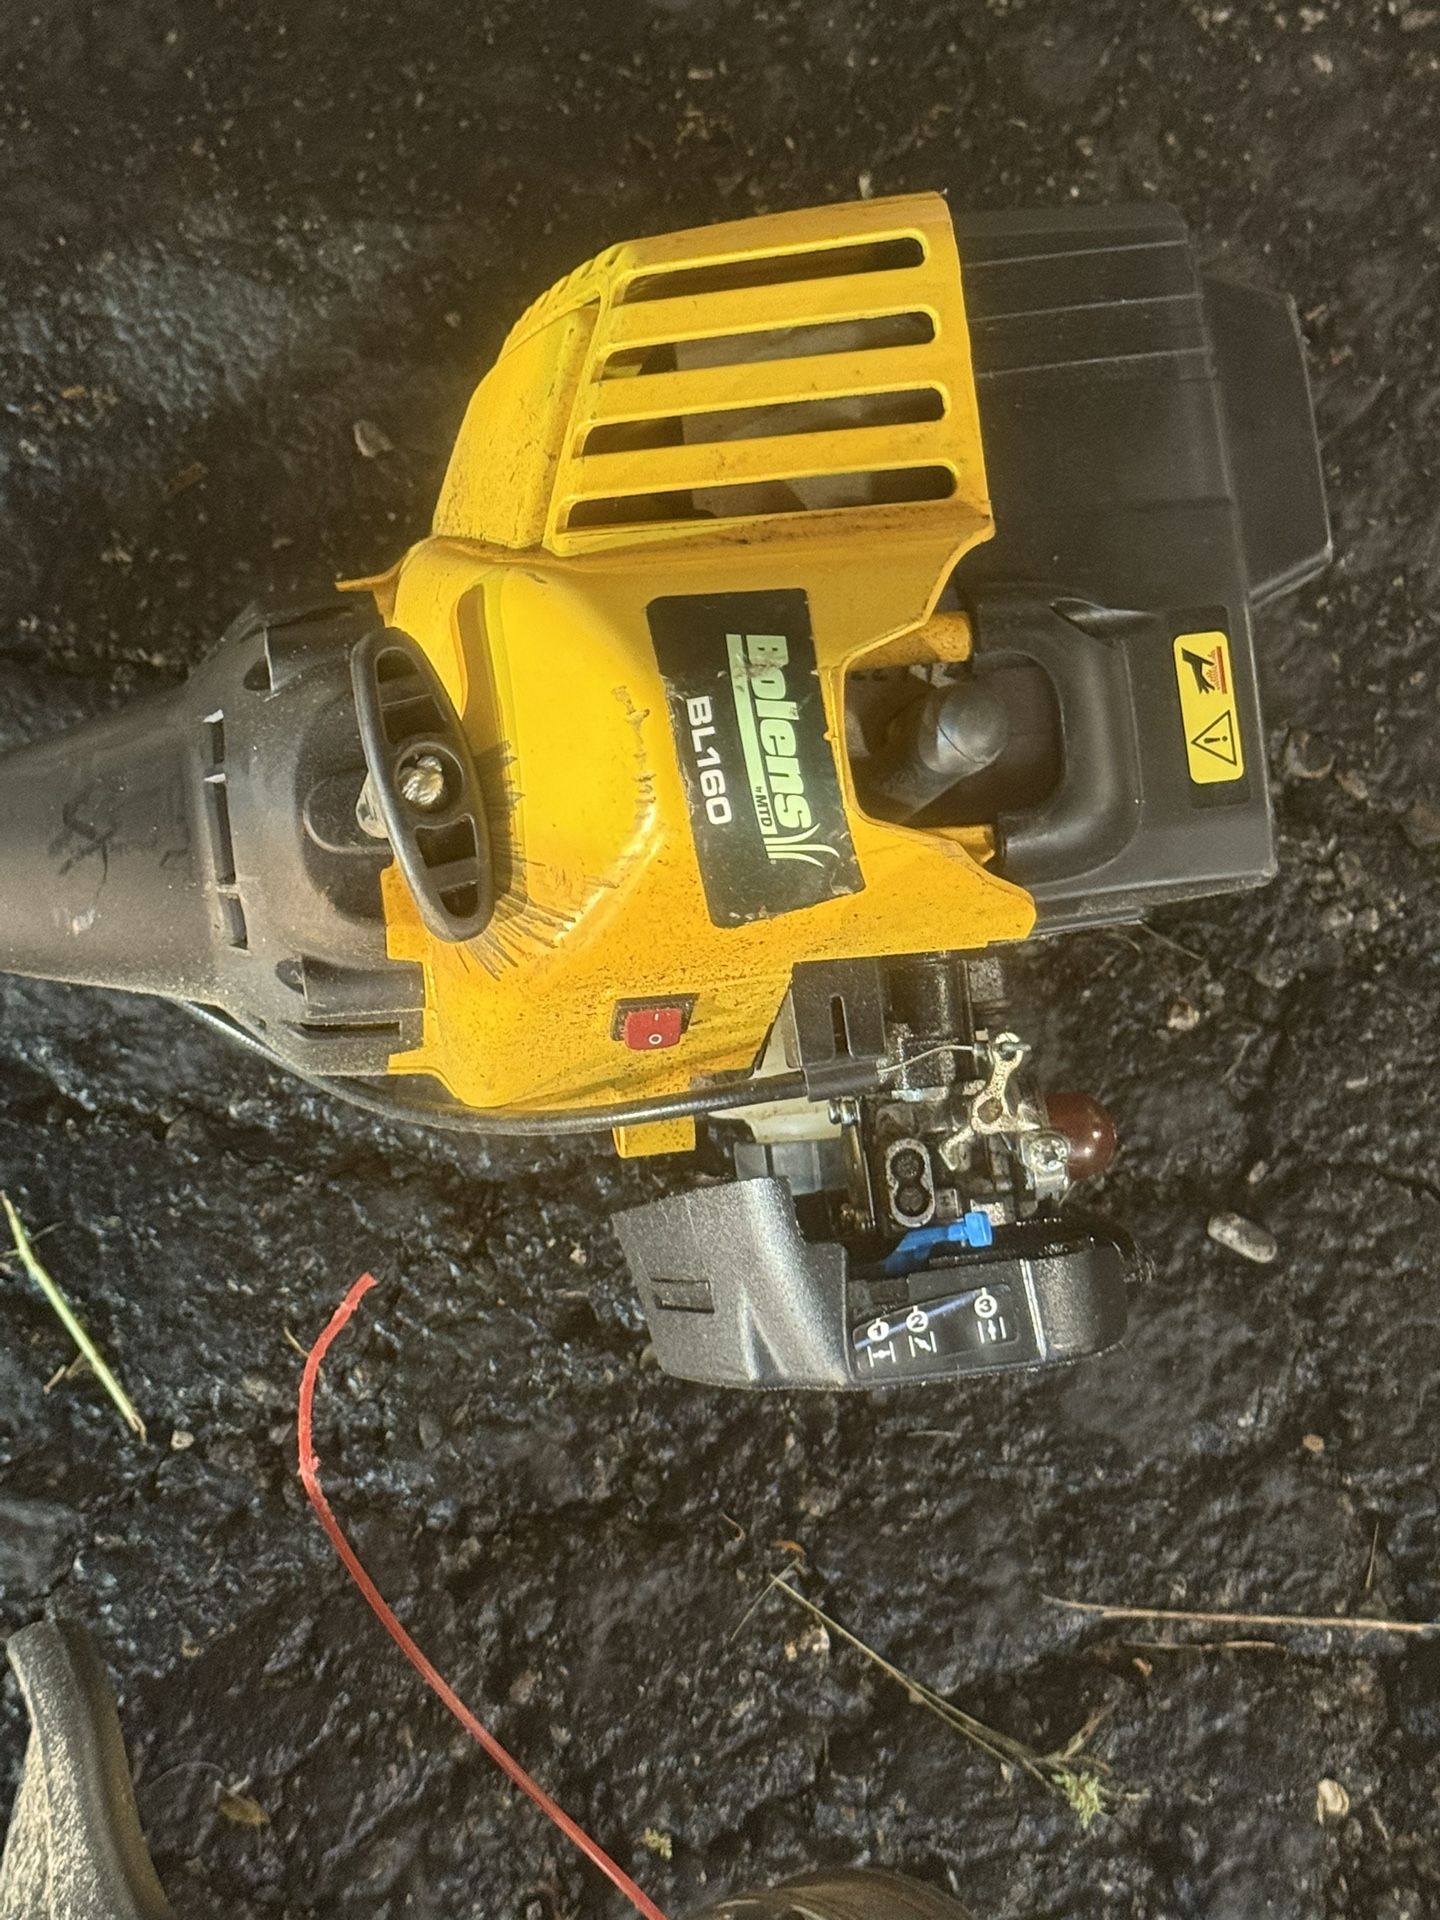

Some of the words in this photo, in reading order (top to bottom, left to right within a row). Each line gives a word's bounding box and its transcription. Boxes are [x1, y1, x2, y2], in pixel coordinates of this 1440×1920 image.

[686, 696, 732, 825] BL160
[746, 634, 811, 829] Bolens
[754, 794, 772, 827] MTD
[911, 1315, 924, 1328] 2
[979, 1299, 992, 1313] 3
